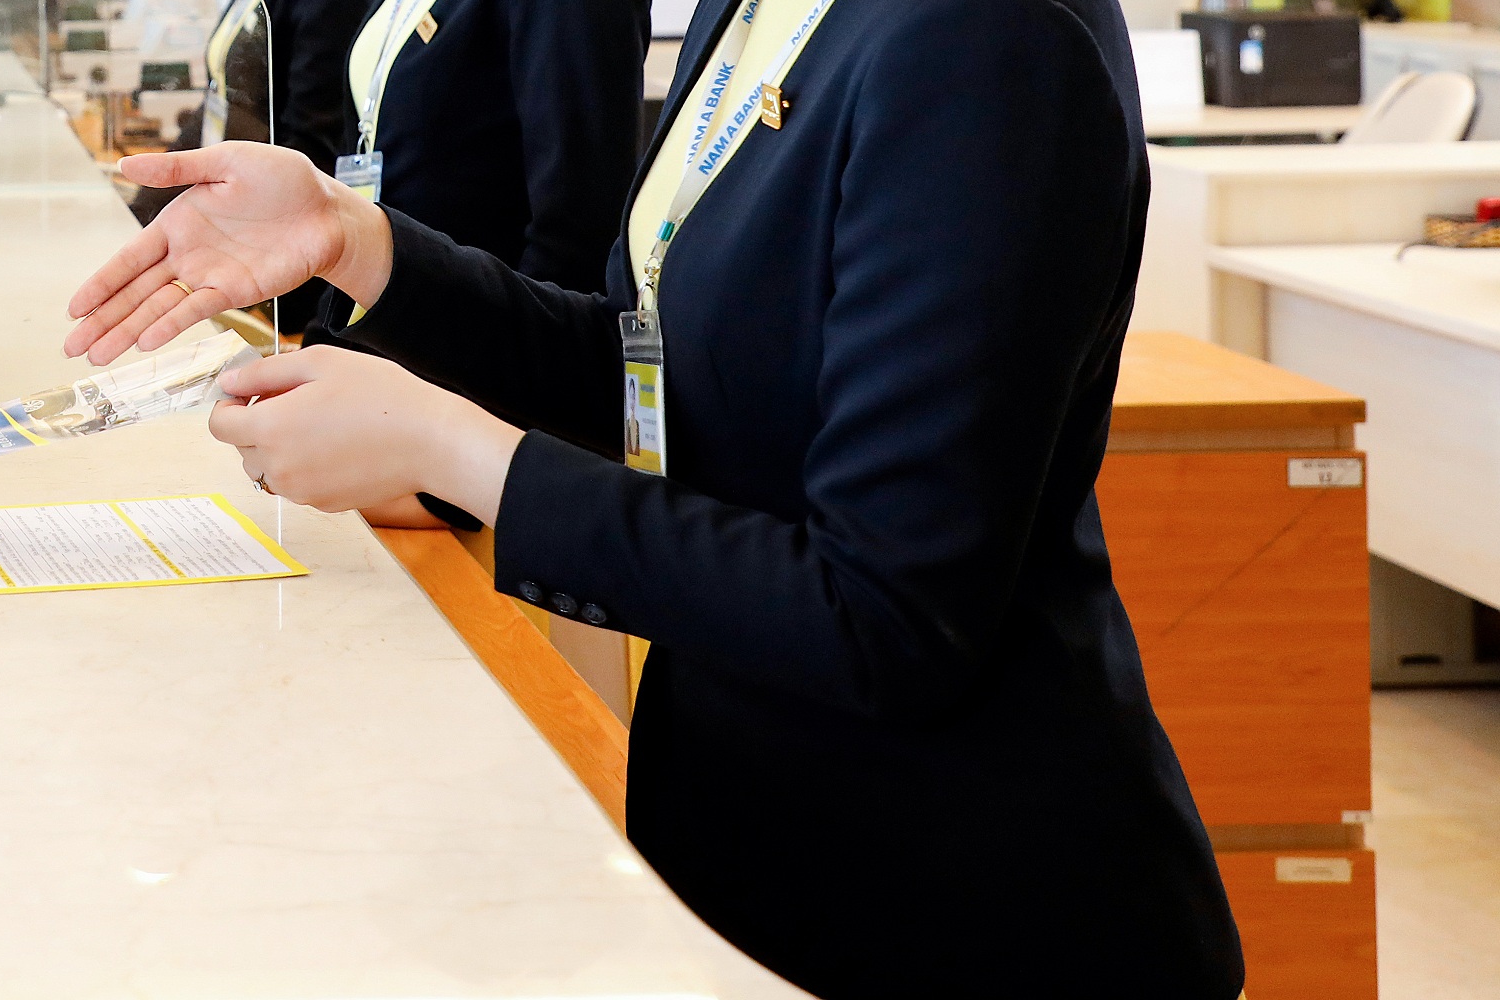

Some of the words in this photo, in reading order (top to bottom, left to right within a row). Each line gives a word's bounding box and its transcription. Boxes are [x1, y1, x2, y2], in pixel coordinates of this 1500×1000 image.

[790, 7, 819, 45] NAM
[705, 61, 735, 107] BANK
[701, 111, 713, 122] A
[687, 125, 707, 164] NAM
[698, 135, 730, 176] NAM
[727, 126, 738, 139] A
